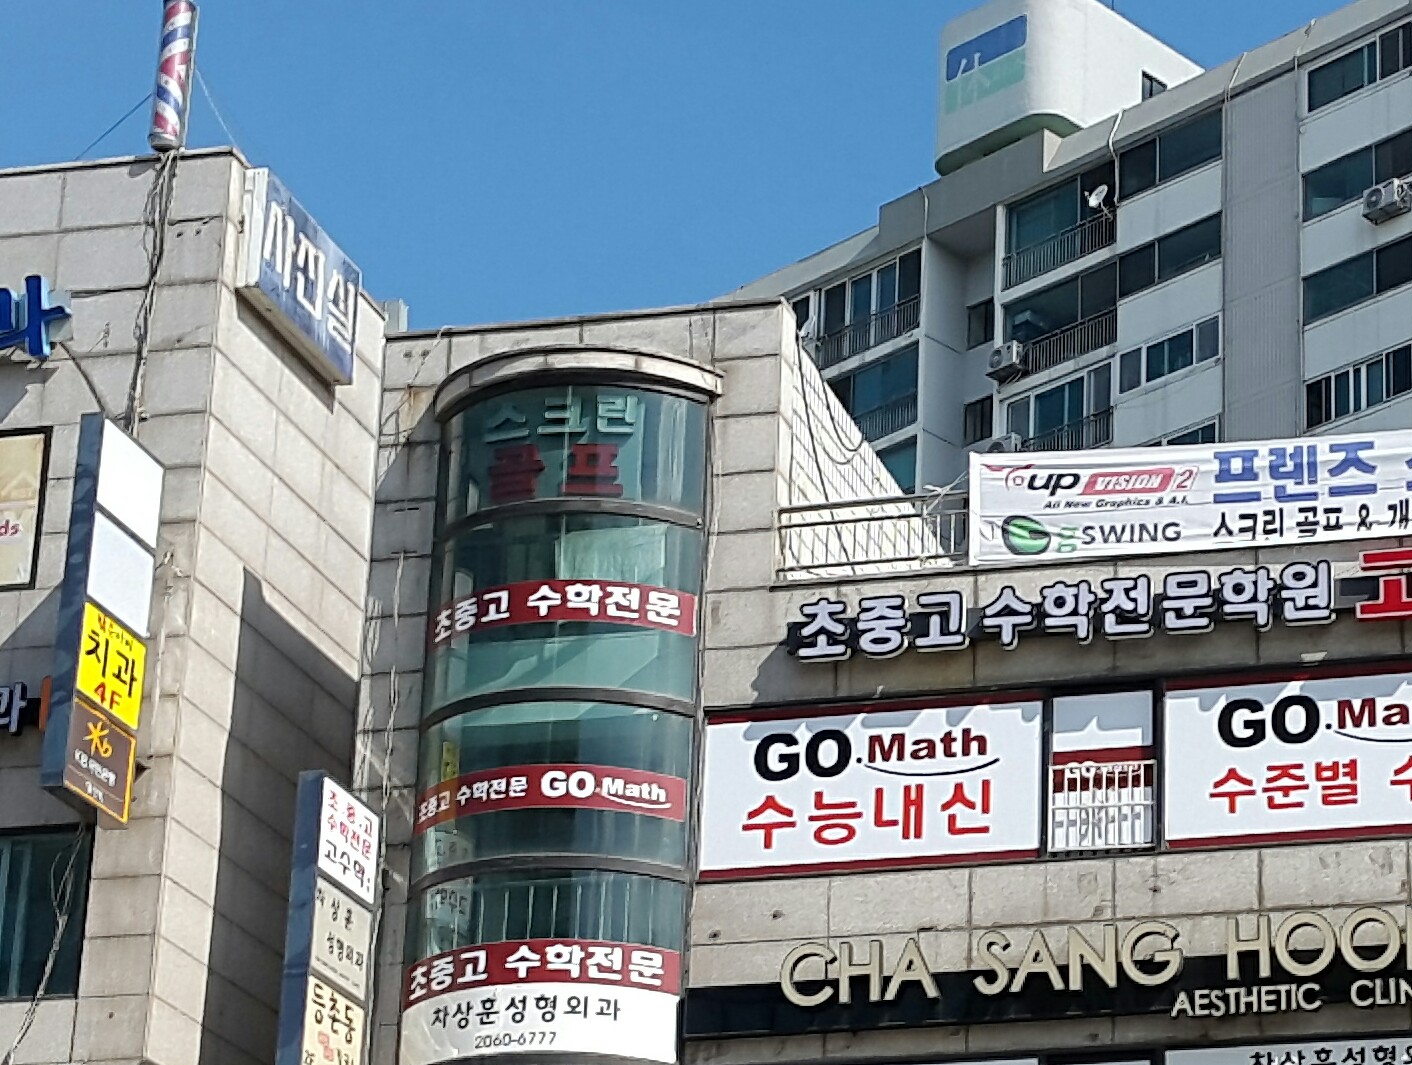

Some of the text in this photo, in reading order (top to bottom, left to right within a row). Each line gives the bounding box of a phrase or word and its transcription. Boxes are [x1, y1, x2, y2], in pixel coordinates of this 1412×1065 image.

[486, 395, 638, 443] 스크린
[1212, 441, 1378, 504] 프렌즈
[433, 582, 681, 643] 초중고 수학전문
[85, 629, 138, 698] 치과
[456, 776, 528, 804] 수학전문
[741, 778, 992, 850] 수능내신
[1209, 755, 1360, 815] 수준별
[408, 951, 488, 1000] 초중고
[504, 944, 664, 986] 수학전문
[780, 938, 941, 1007] CHA
[973, 920, 1184, 995] SANG
[1170, 983, 1322, 1019] AESTHETIC
[474, 1032, 557, 1050] 2060-6777
